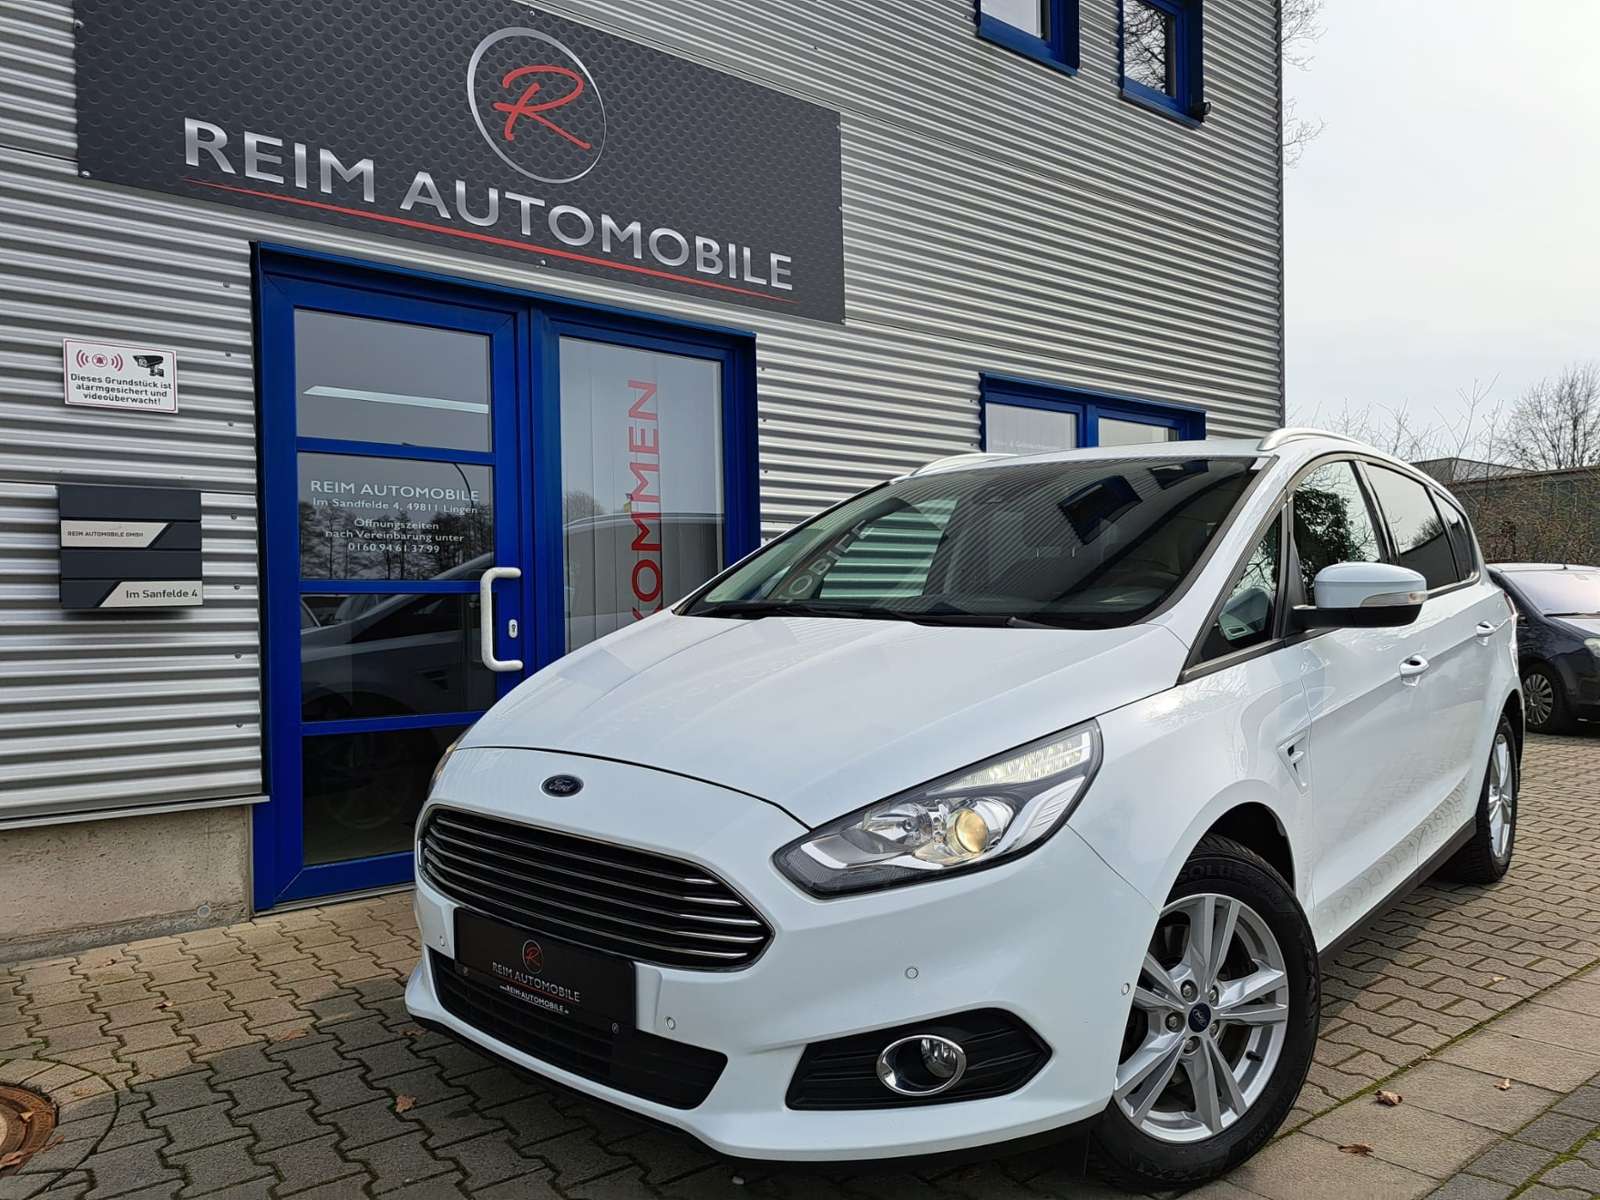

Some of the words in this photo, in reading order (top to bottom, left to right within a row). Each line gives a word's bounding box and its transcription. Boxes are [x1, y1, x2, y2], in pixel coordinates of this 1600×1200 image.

[493, 64, 591, 151] R
[184, 117, 375, 203] REIM
[399, 171, 793, 292] AUTOMOBILE
[70, 373, 104, 384] Dieses
[105, 376, 158, 389] Grundstück
[160, 381, 171, 390] ist
[75, 383, 148, 397] alarmgesichert
[150, 390, 167, 398] und
[83, 392, 161, 406] videoüberwacht!
[310, 480, 355, 494] REIM
[360, 483, 480, 502] AUTOMOBILE
[313, 497, 328, 506] Im
[332, 498, 389, 510] Sandfelde
[406, 502, 438, 513] 49811
[443, 505, 478, 516] Lingen
[325, 530, 353, 538] nach
[355, 530, 432, 543] Vereinbarung
[435, 534, 464, 542] unter
[126, 590, 140, 599] Im
[143, 589, 189, 599] Sanfelde
[191, 589, 198, 598] 4
[492, 961, 513, 979] REIM
[514, 971, 581, 1002] AUTOMOBILE
